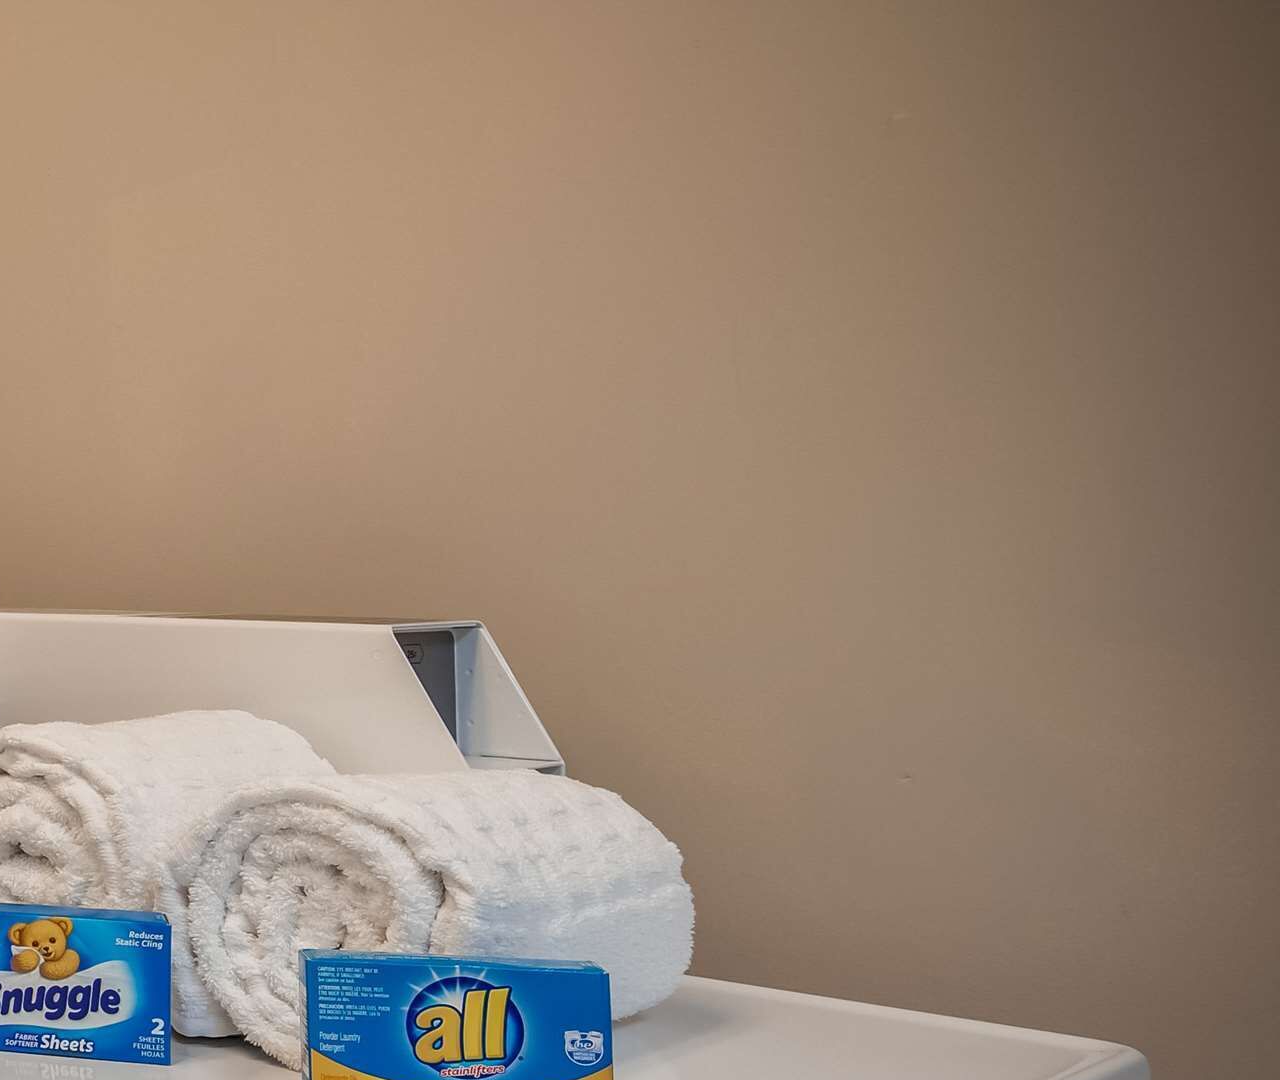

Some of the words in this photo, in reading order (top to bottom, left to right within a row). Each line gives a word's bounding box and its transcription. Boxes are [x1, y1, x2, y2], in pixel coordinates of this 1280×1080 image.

[129, 931, 164, 940] Reduces
[115, 938, 140, 947] Static
[142, 940, 163, 950] Cling
[151, 1018, 165, 1035] 2
[414, 986, 512, 1065] all
[14, 1033, 39, 1041] FABRIC
[138, 1036, 165, 1044] SHEETS
[4, 1038, 39, 1048] SOFTENER
[40, 1034, 94, 1053] Sheets
[132, 1042, 165, 1051] FEUILLES
[141, 1050, 165, 1058] HOJAS
[440, 1064, 505, 1078] stainlifters
